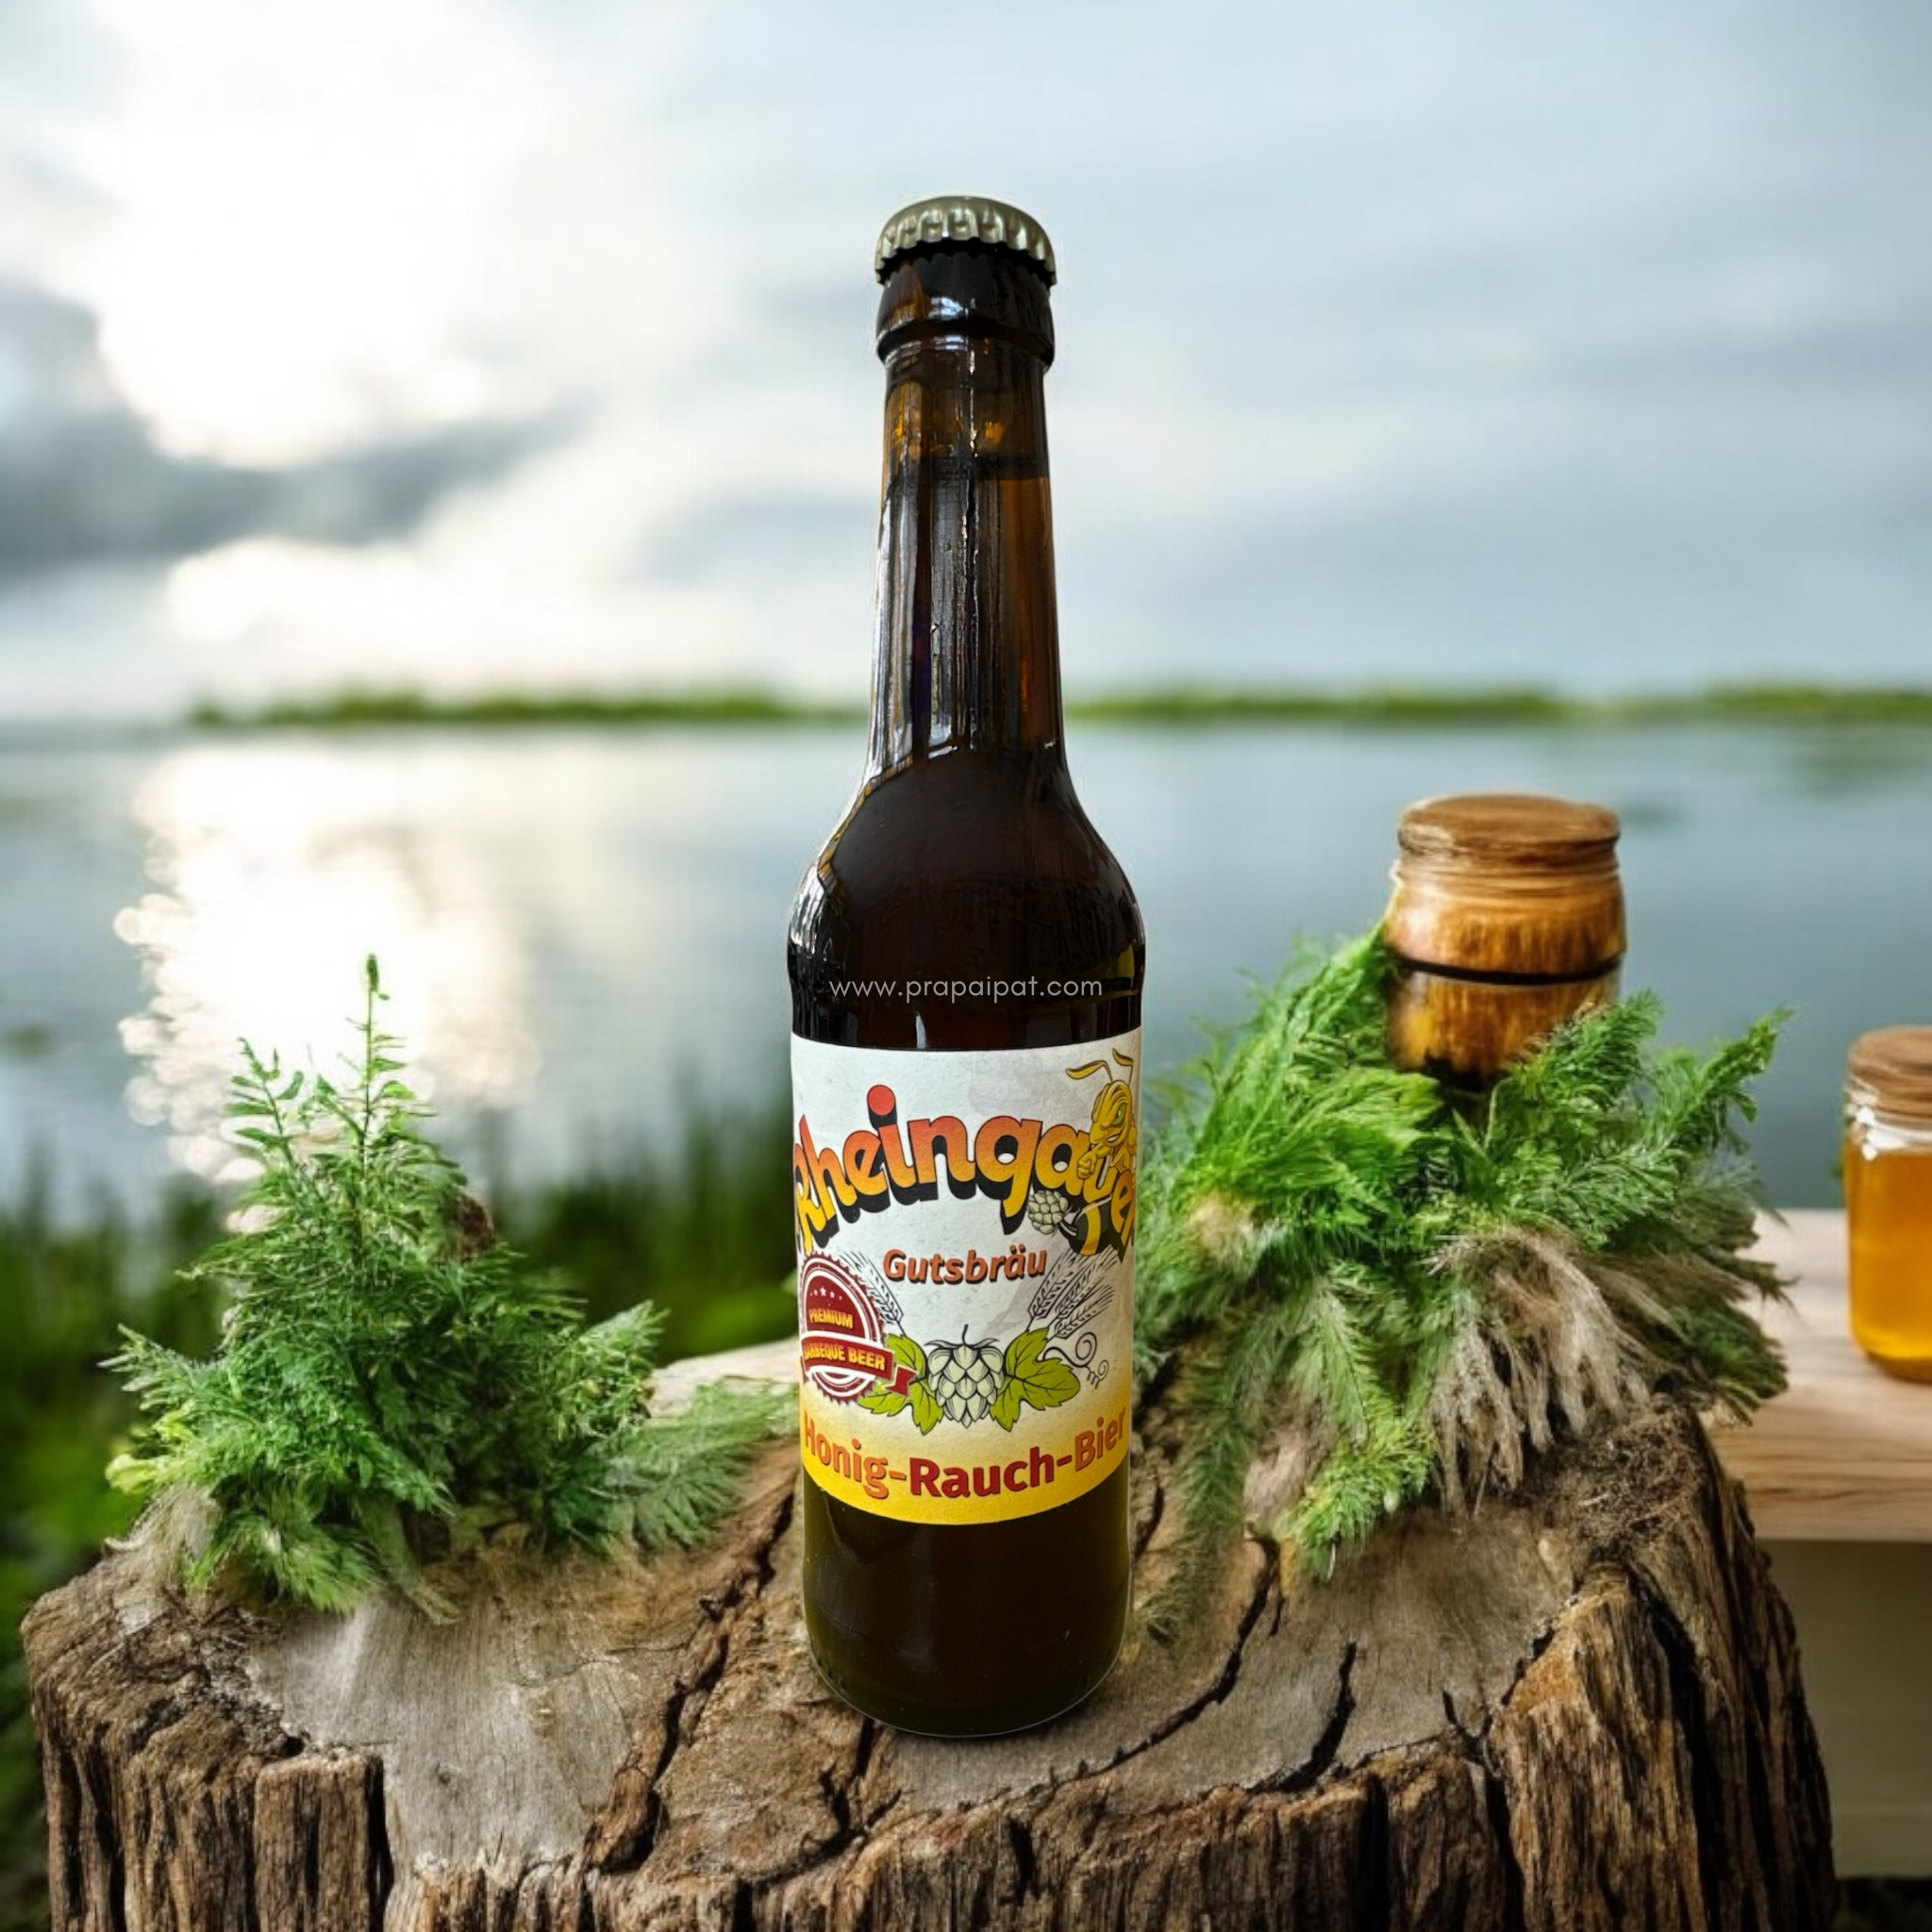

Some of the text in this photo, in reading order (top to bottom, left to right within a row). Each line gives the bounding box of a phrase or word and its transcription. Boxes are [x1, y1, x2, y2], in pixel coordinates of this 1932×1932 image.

[883, 1244, 1047, 1284] Gutsbräu
[808, 1307, 854, 1329] PREMIUM
[847, 1346, 886, 1371] BEER
[805, 1407, 1126, 1499] Honig-Rauch-Bier
